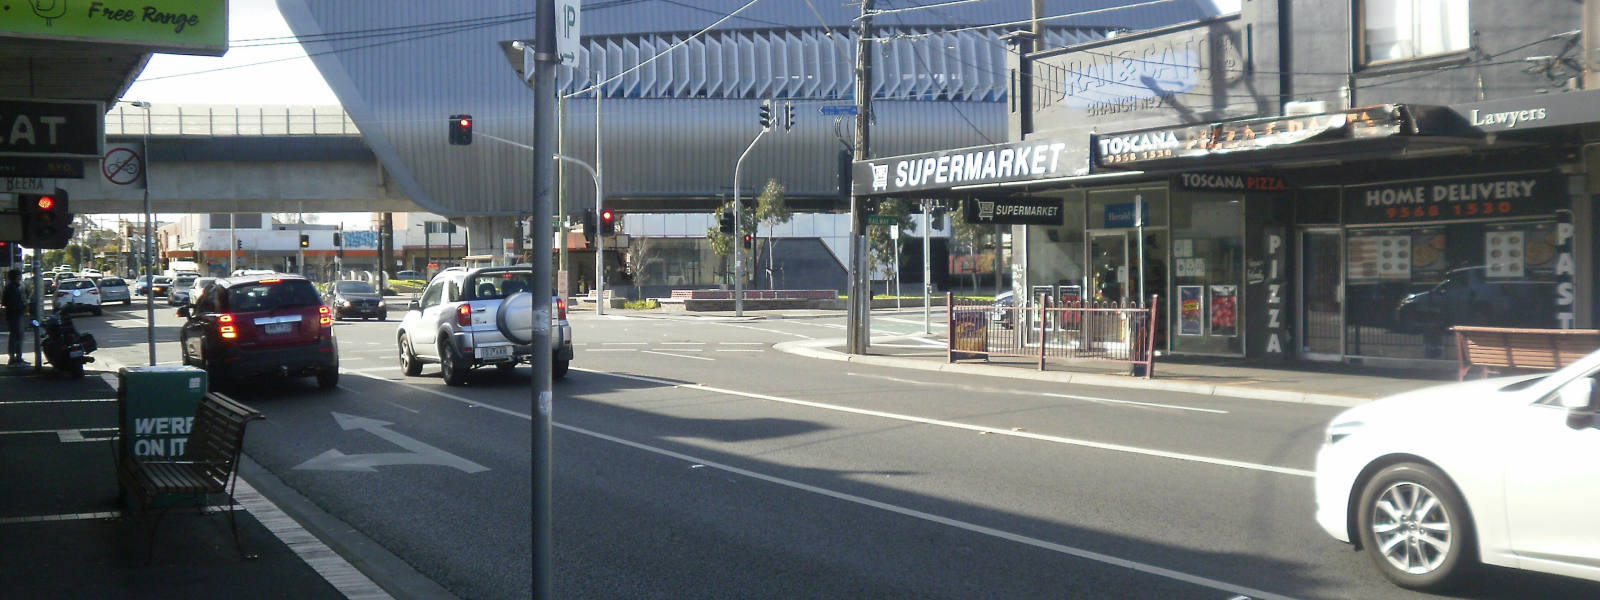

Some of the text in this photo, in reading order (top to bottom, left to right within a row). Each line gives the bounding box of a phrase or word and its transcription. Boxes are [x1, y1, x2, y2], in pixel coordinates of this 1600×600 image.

[88, 2, 199, 34] Free Range
[563, 4, 576, 39] 1P
[0, 114, 66, 145] AT
[1471, 106, 1546, 128] Lawyers
[1099, 130, 1179, 155] TOSCANA
[894, 142, 1065, 187] SUPERMARKET
[1182, 173, 1285, 190] TOSCANA PIZZA
[1366, 180, 1536, 207] HOME DELIVERY
[995, 203, 1059, 217] SUPERMARKET
[1453, 202, 1511, 216] 1530
[1266, 234, 1282, 353] PIZZA
[134, 437, 188, 457] ON IT
